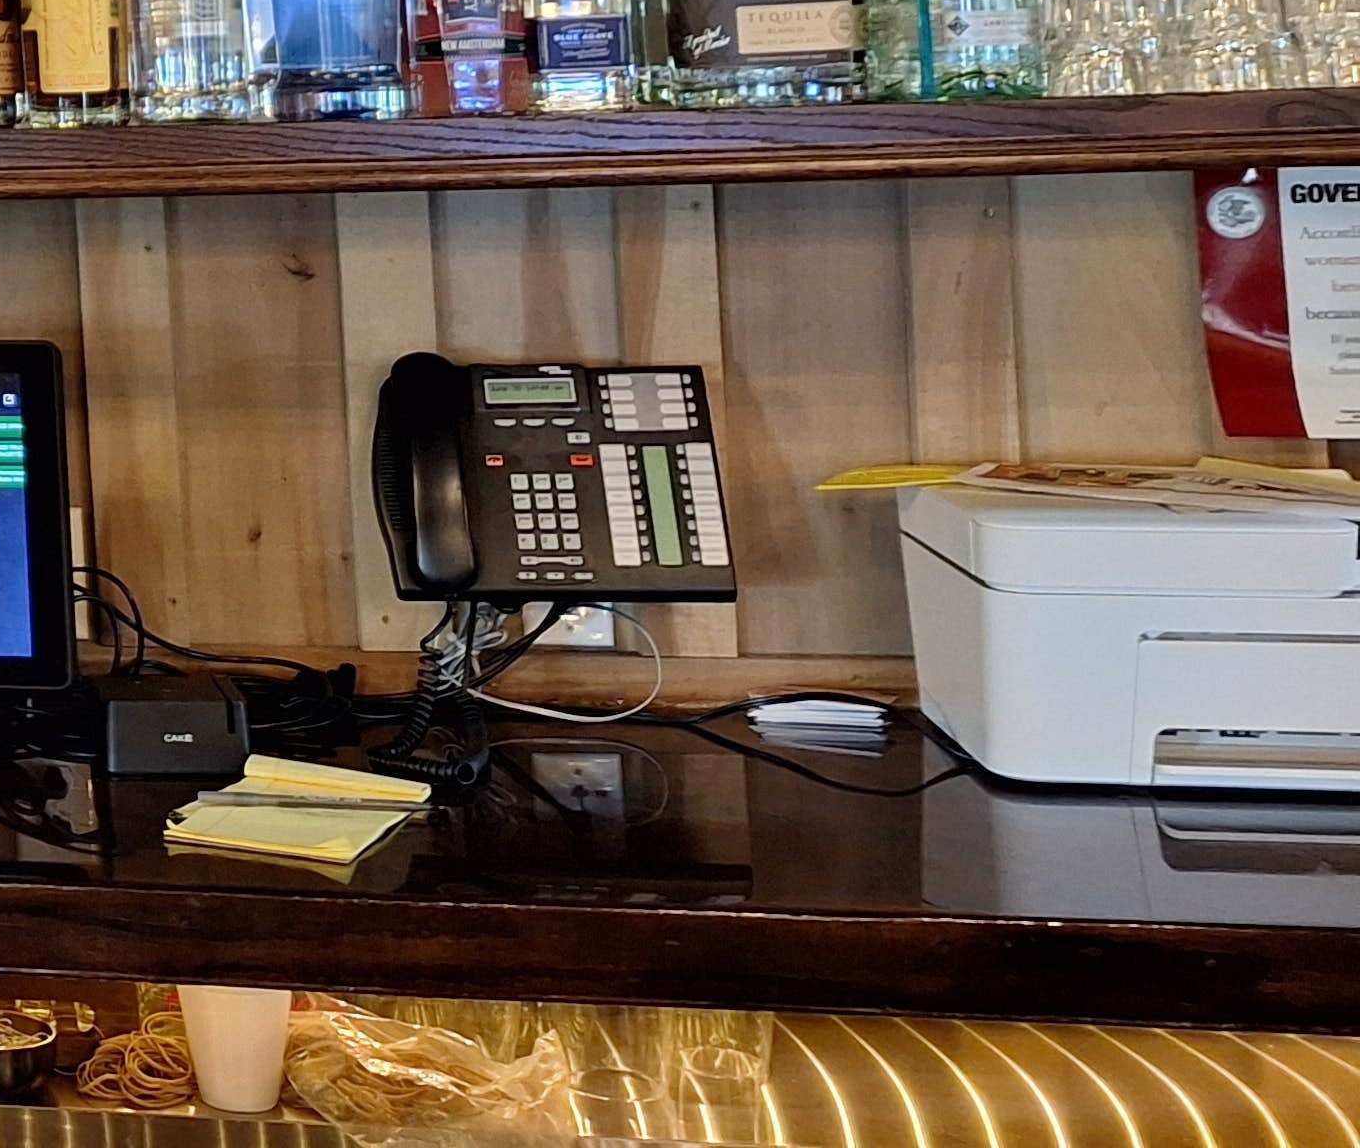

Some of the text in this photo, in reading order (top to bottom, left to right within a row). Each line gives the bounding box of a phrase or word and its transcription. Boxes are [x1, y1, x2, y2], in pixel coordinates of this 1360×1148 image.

[747, 9, 824, 23] TEQUILA
[1290, 183, 1360, 203] GOVE
[164, 733, 193, 742] CAKE
